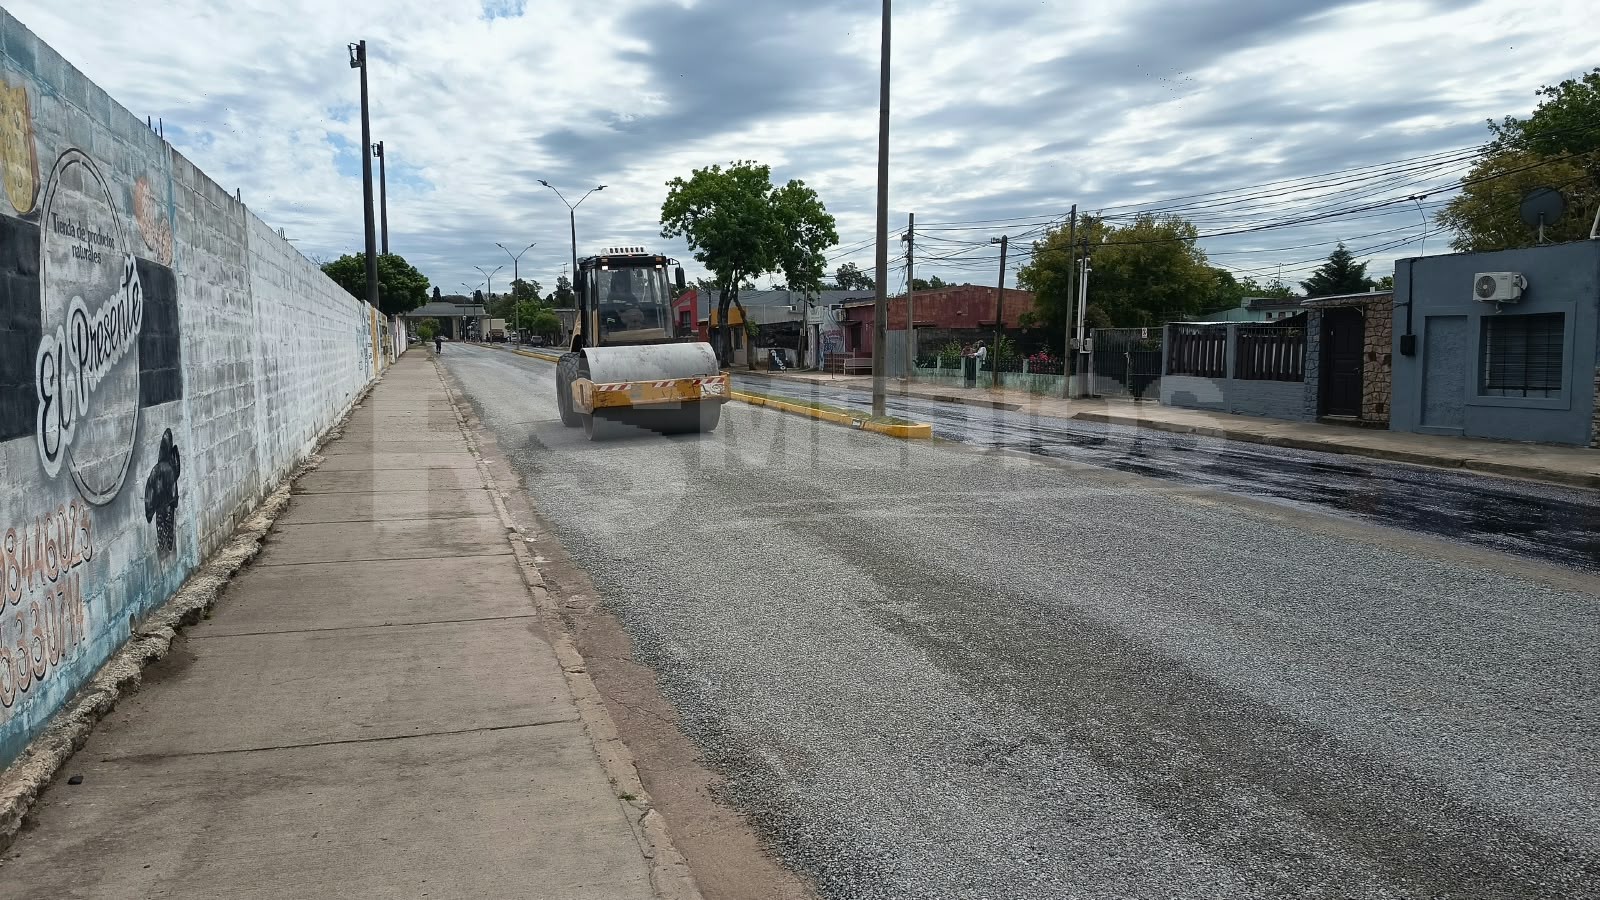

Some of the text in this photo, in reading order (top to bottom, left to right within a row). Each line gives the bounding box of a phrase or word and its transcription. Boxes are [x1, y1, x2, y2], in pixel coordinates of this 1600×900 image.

[51, 211, 115, 251] Tienda de productos
[71, 244, 102, 264] naturales
[38, 258, 142, 466] El Presente
